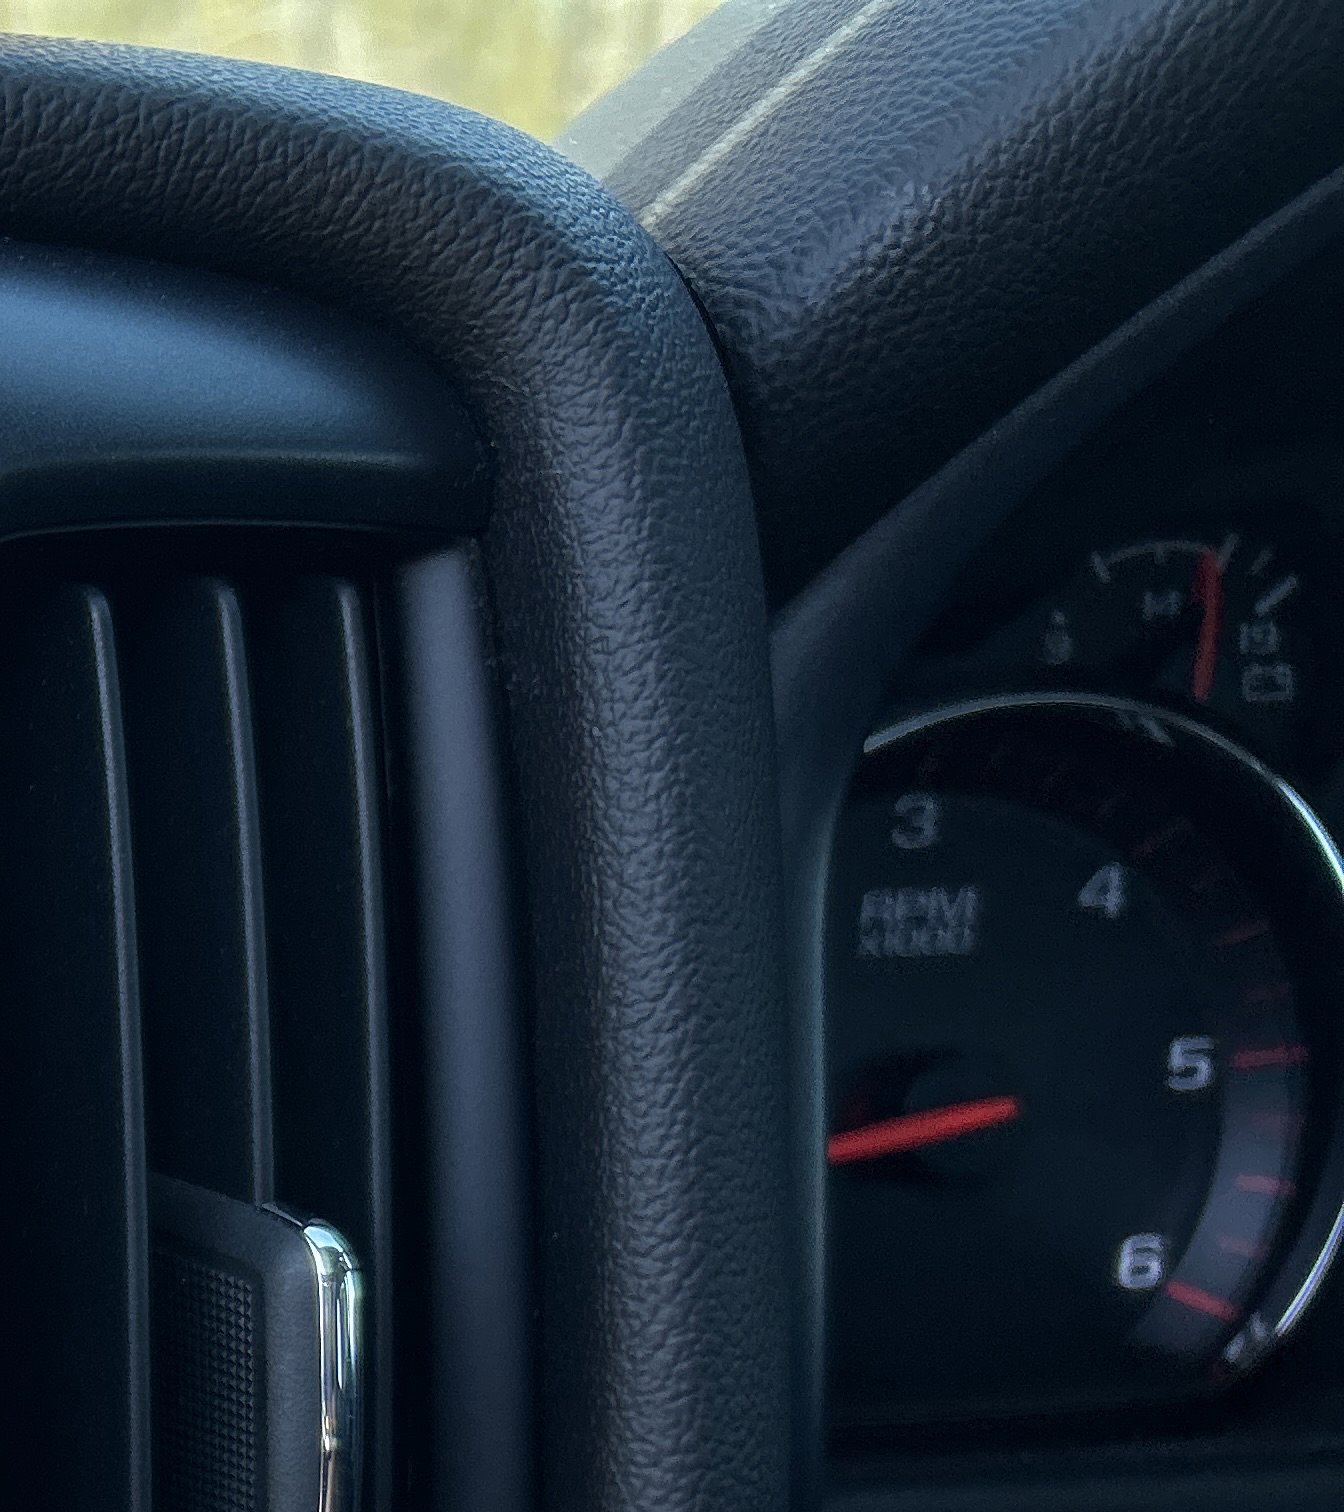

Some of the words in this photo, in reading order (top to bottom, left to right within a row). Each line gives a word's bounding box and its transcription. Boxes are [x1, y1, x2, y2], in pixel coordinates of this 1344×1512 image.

[892, 793, 940, 848] 3
[1078, 862, 1127, 918] 4
[1167, 1036, 1213, 1091] 5
[1117, 1232, 1165, 1289] 6
